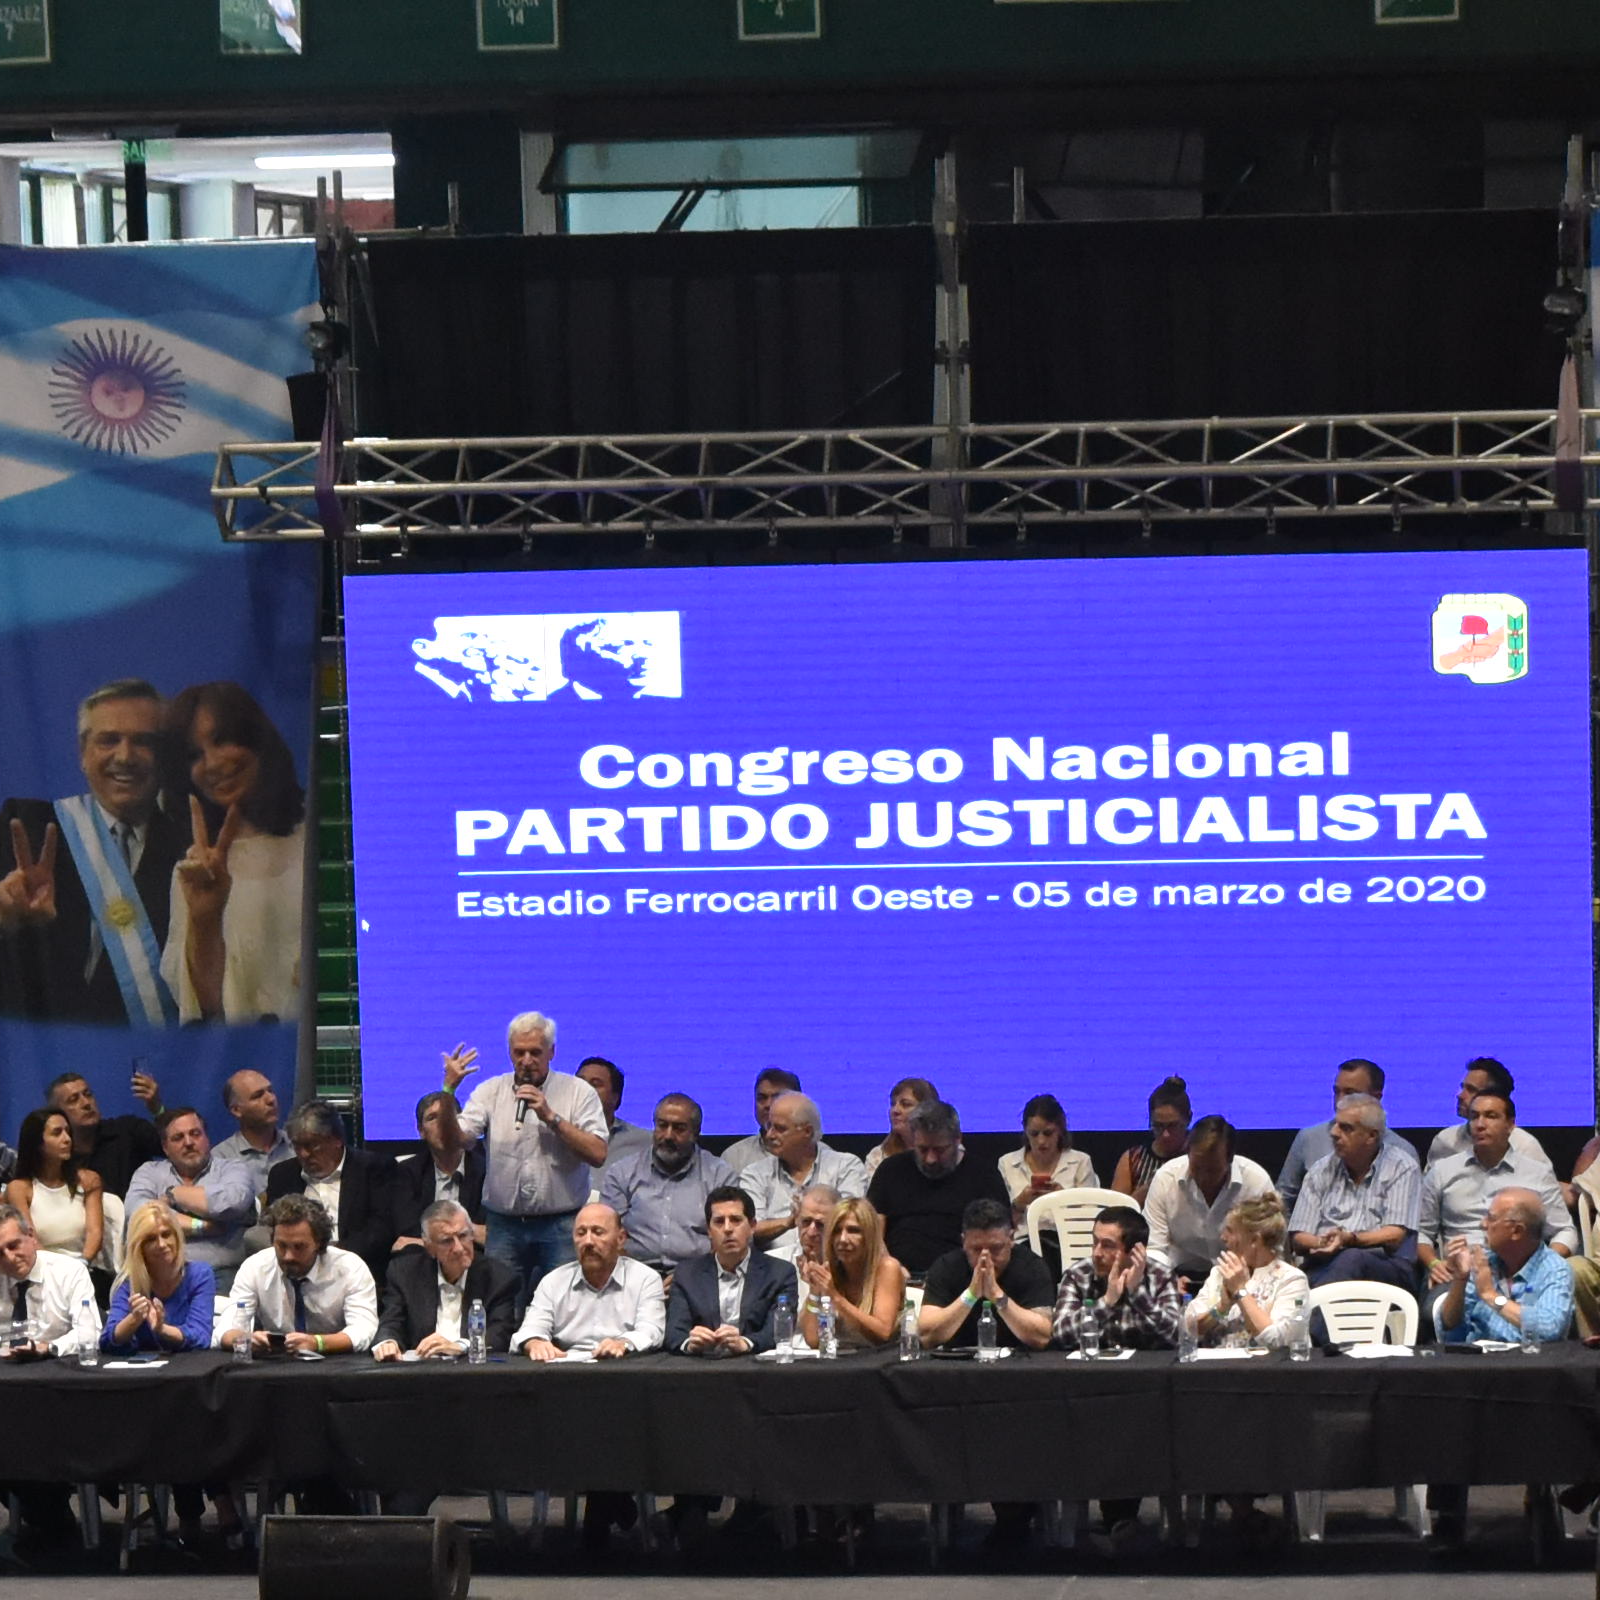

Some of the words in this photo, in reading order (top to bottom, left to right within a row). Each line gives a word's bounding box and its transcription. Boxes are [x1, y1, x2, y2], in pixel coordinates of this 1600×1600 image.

[255, 12, 270, 30] 12
[507, 8, 524, 24] 14
[4, 23, 14, 41] 7
[580, 744, 964, 796] Congreso
[992, 731, 1349, 781] Nacional
[456, 803, 829, 856] PARTIDO
[856, 793, 1487, 850] JUSTICIALISTA
[457, 889, 611, 917] Estadio
[626, 885, 837, 914] Ferrocarril
[852, 885, 973, 911] Oeste
[1013, 882, 1070, 908] 05
[1085, 881, 1137, 907] de
[1154, 884, 1284, 906] marzo
[1299, 878, 1351, 904] de
[1367, 876, 1486, 902] 2020
